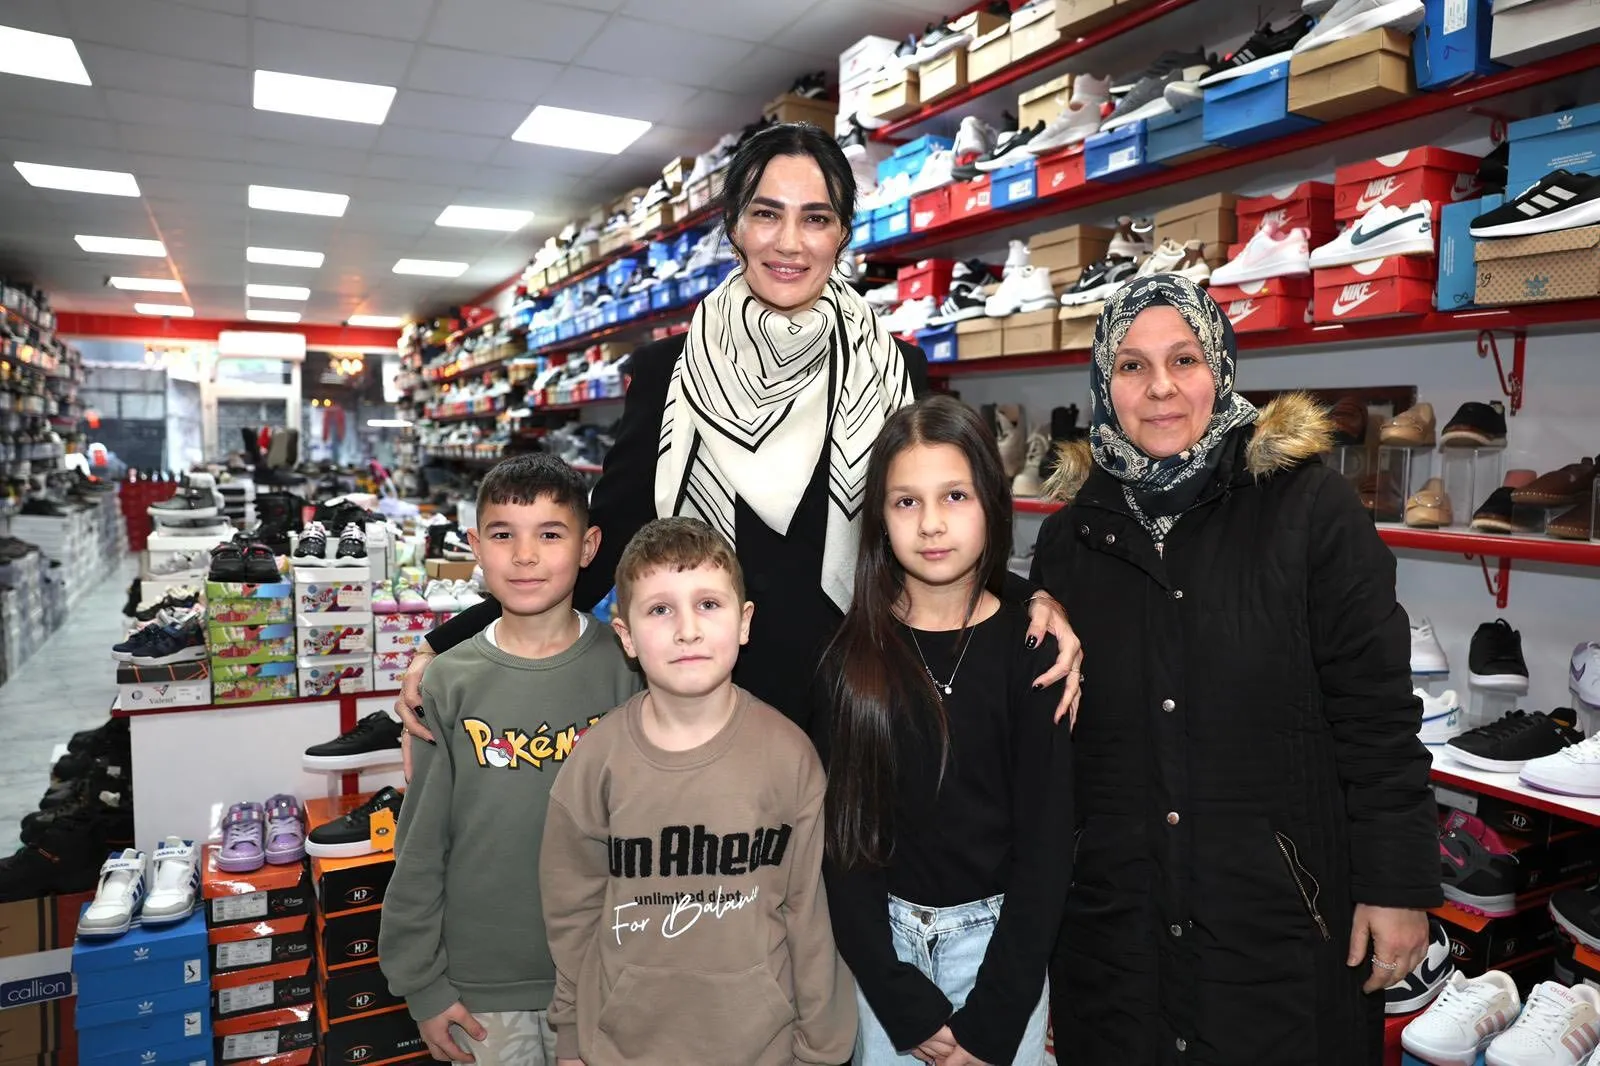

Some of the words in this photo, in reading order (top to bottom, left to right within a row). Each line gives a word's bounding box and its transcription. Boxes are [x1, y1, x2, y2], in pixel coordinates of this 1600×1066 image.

[1364, 176, 1396, 198] NIKE
[1339, 281, 1371, 302] NIKE
[1228, 299, 1254, 315] NIKE
[463, 716, 601, 771] Pokém
[608, 835, 653, 878] un
[612, 902, 650, 945] For
[7, 980, 66, 1002] callion
